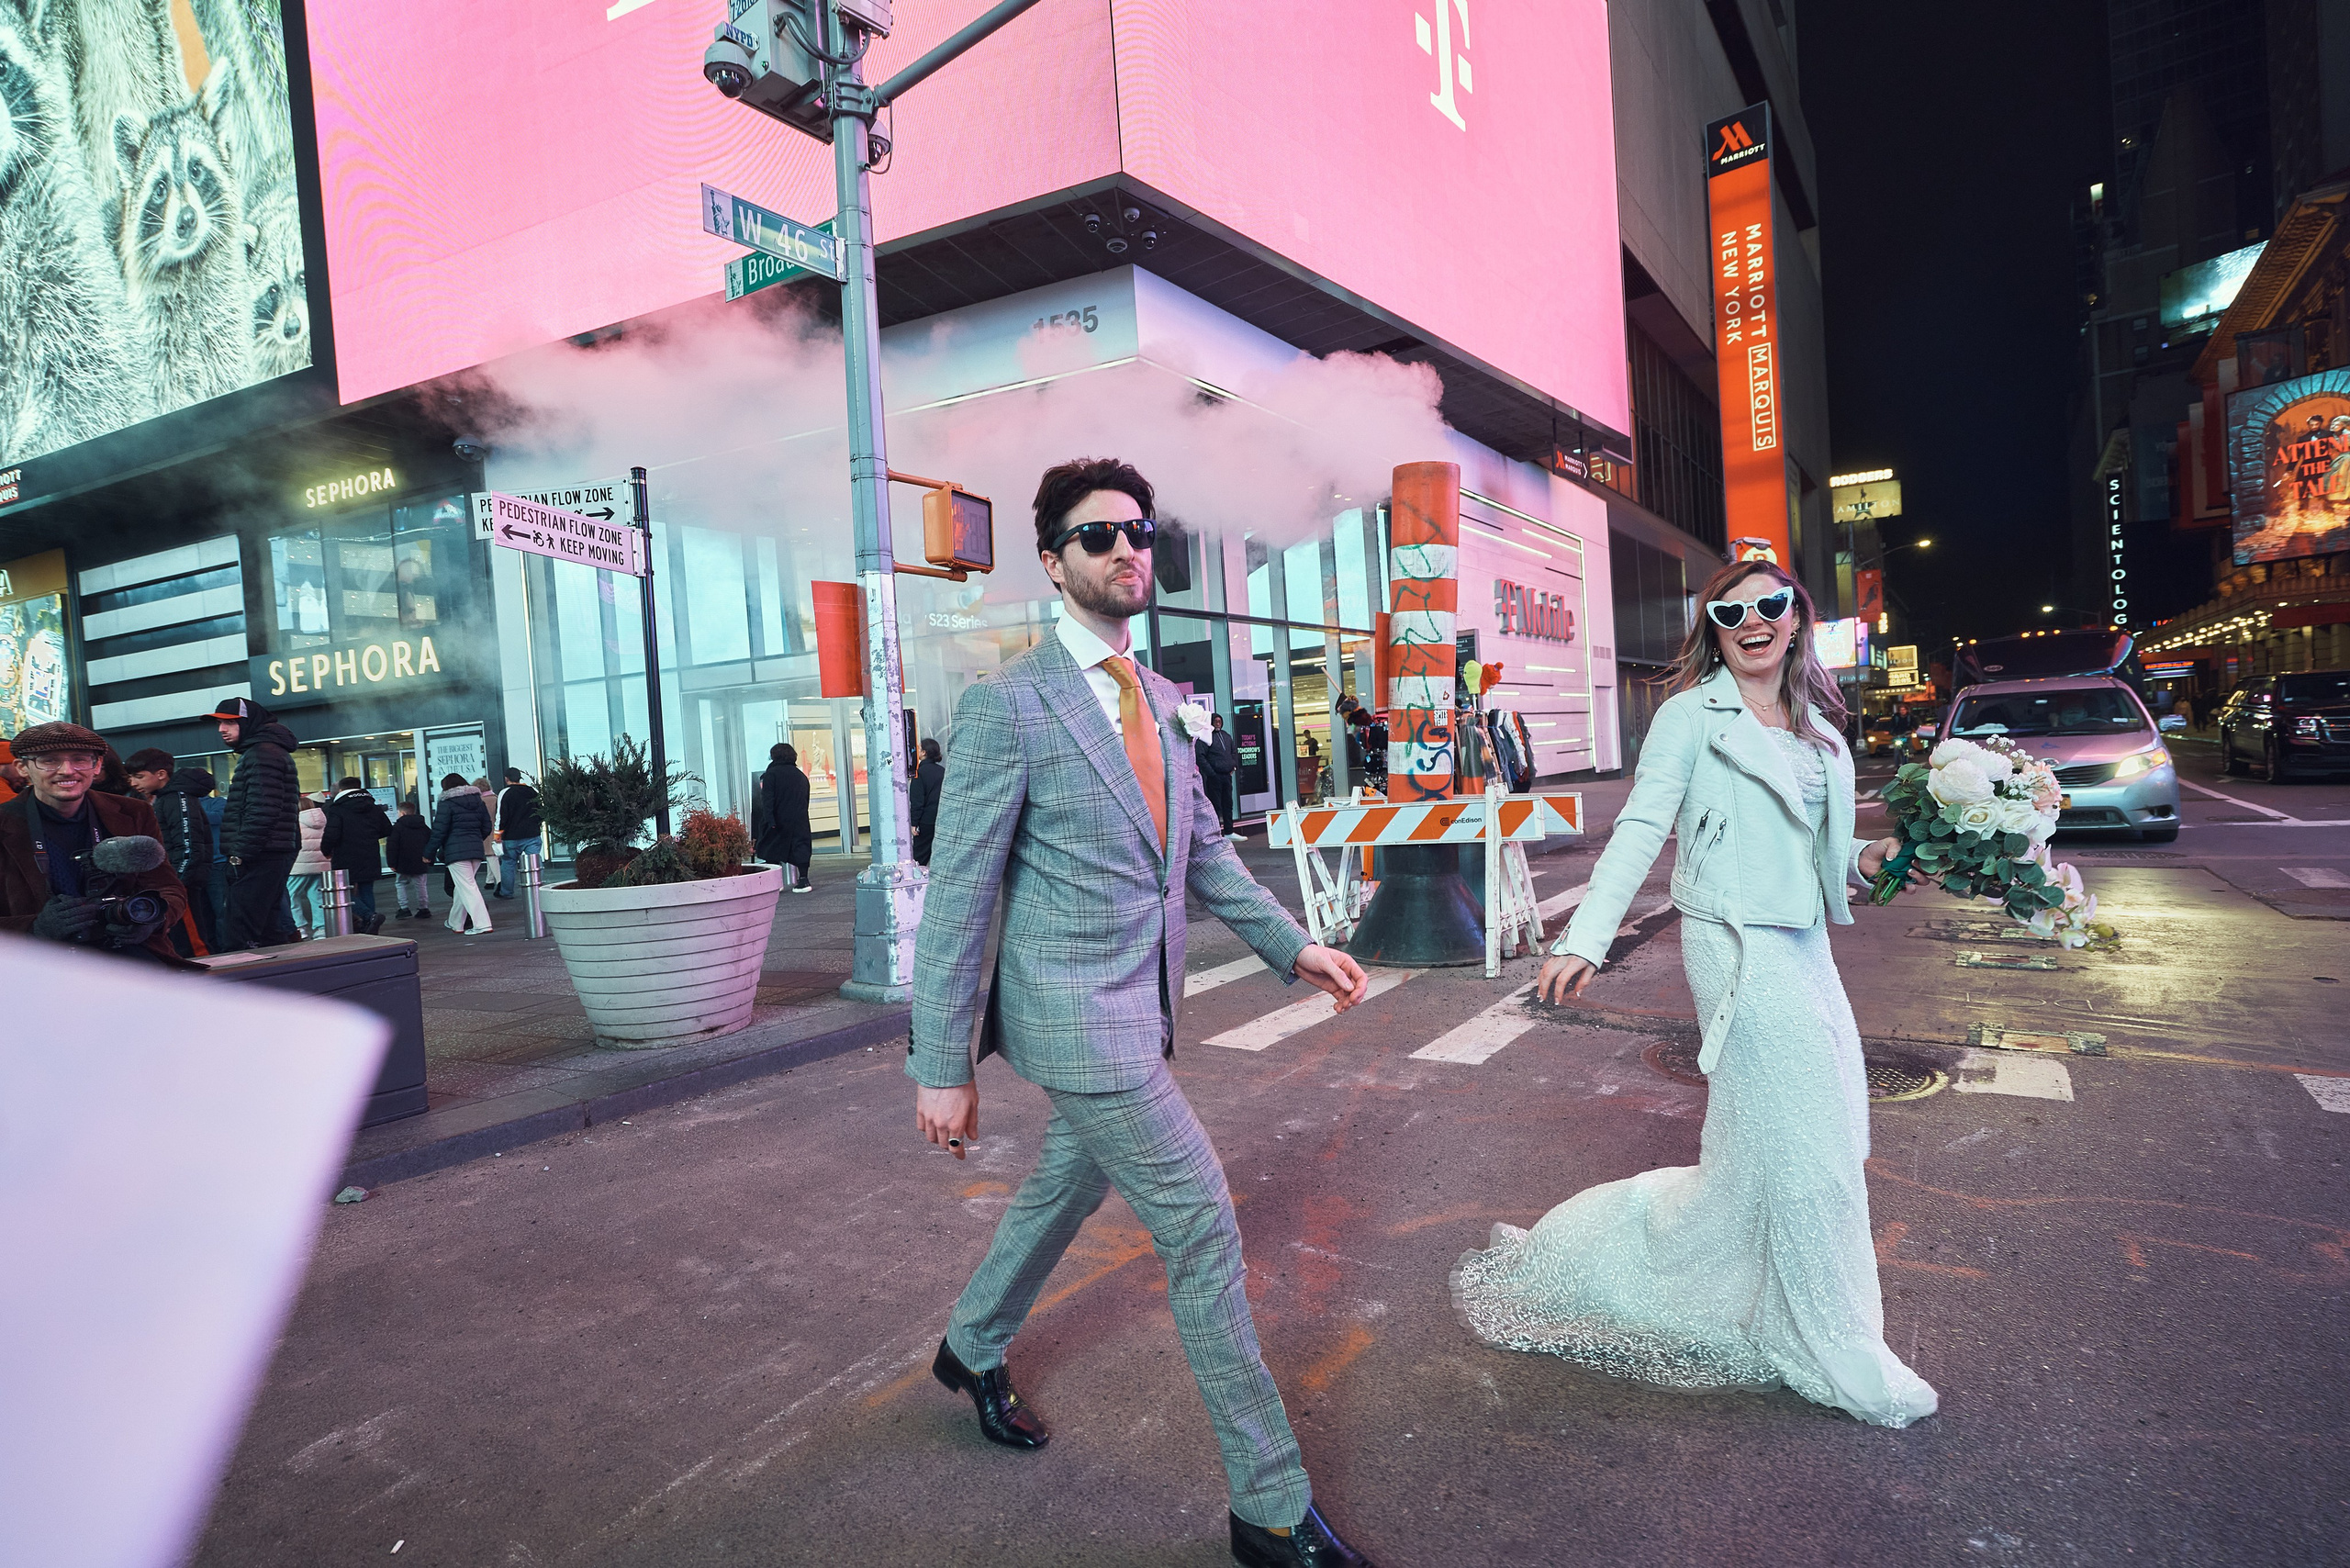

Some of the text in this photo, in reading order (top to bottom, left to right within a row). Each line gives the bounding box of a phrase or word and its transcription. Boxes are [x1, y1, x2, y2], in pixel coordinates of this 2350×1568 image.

[725, 22, 753, 48] NYPD
[1720, 143, 1766, 165] MARRIOTT
[737, 205, 835, 262] W 46 St
[748, 252, 796, 286] Broa
[1721, 230, 1742, 345] NEW YORK
[1034, 305, 1099, 344] 1535
[1745, 223, 1773, 448] MARRIOTT MARQUIS
[2300, 459, 2333, 477] THE
[305, 467, 396, 508] SEPHORA
[551, 490, 581, 507] FLOW
[585, 487, 614, 503] ZONE
[2288, 474, 2346, 501] TALE
[1833, 498, 1901, 514] AMILTON
[498, 499, 623, 546] PEDESTRIAN FLOW ZONE
[559, 537, 624, 566] KEEP MOVING
[928, 613, 949, 626] S23
[951, 614, 989, 628] Series
[268, 636, 441, 696] SEPHORA
[437, 744, 474, 755] THE BIGGEST
[437, 753, 476, 766] SEPHORA
[461, 764, 476, 774] USA
